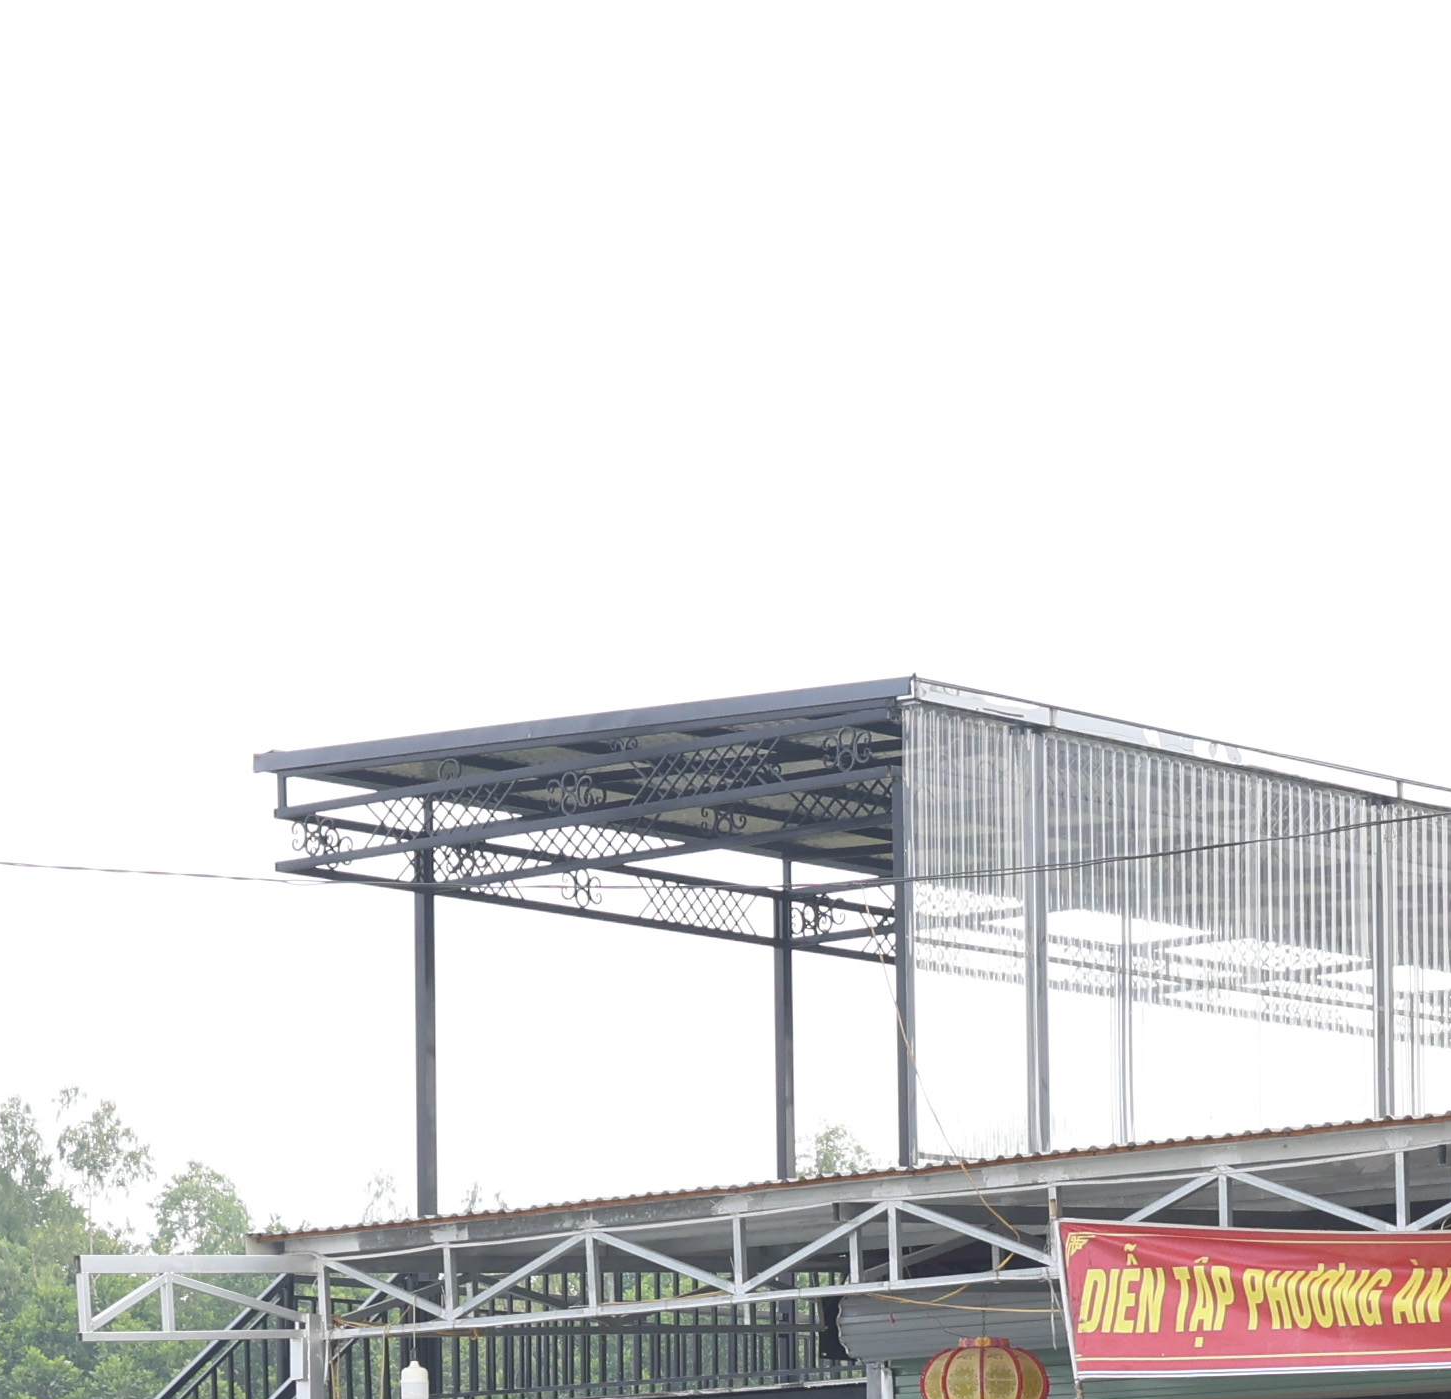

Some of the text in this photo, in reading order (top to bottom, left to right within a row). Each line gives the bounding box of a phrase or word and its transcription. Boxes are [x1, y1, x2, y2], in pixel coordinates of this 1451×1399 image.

[1077, 1243, 1167, 1333] DIỄN
[1173, 1256, 1236, 1348] TẬP
[1242, 1262, 1392, 1331] PHƯƠNG
